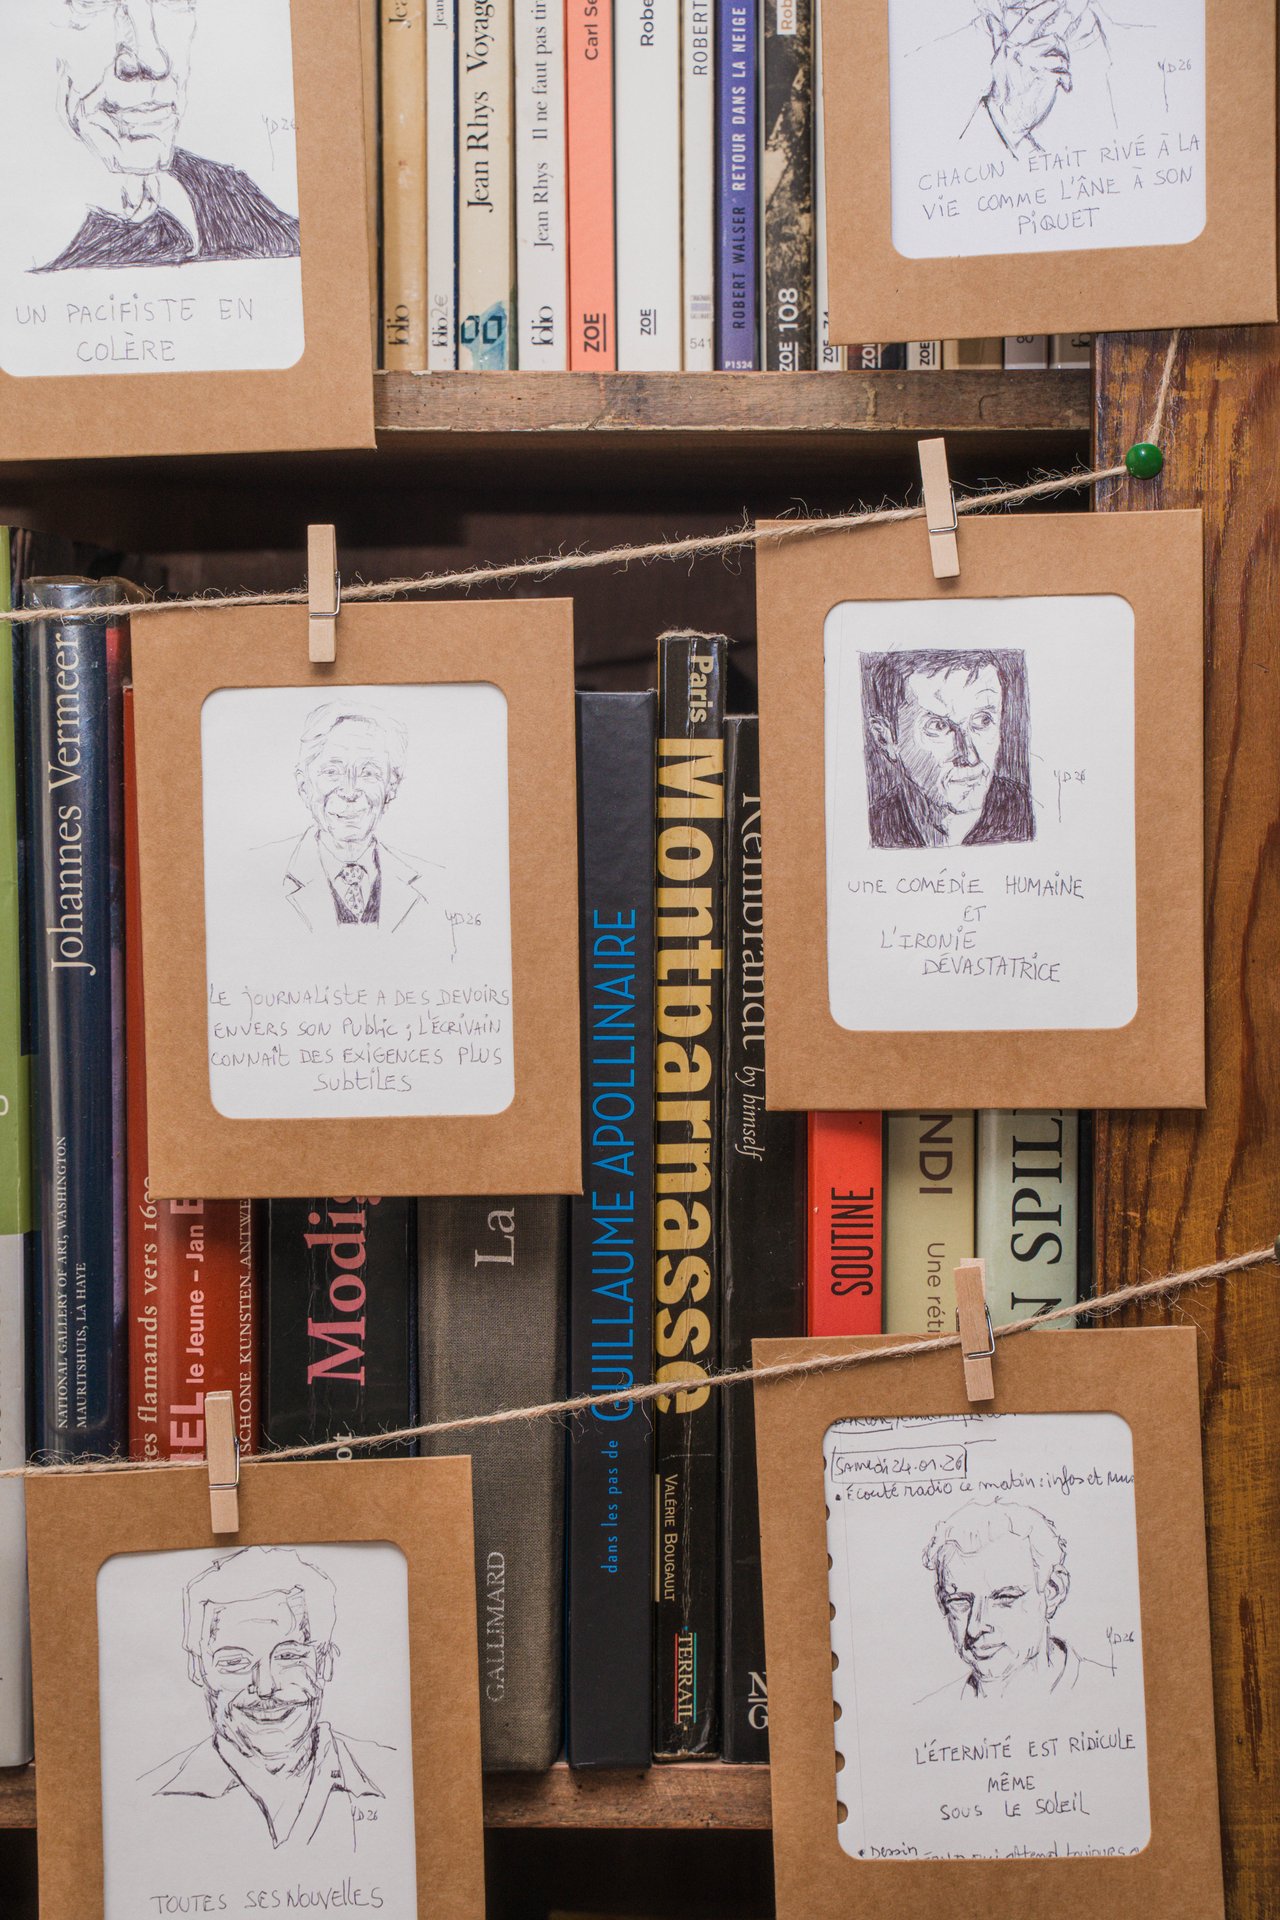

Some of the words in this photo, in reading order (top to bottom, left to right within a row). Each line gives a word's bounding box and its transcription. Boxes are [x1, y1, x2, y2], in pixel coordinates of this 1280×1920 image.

[535, 26, 552, 55] pas
[584, 24, 599, 60] Carl
[692, 0, 708, 76] ROBERT
[731, 7, 747, 53] NEIGE
[531, 60, 548, 96] faut
[731, 61, 746, 78] LA
[466, 91, 495, 151] Rhys
[535, 101, 548, 121] ne
[731, 86, 747, 125] DANS
[532, 161, 554, 203] Rhys
[731, 133, 747, 191] RETOUR
[918, 160, 1005, 191] CHACUN
[1178, 132, 1200, 152] LA
[466, 160, 494, 213] Jean
[977, 188, 1048, 213] COMME
[1153, 166, 1193, 187] SON
[533, 211, 554, 251] Jean
[732, 206, 746, 264] WALSER
[15, 303, 47, 325] UN
[219, 298, 253, 321] EN
[732, 272, 746, 329] ROBERT
[777, 287, 799, 332] 108
[531, 305, 554, 347] folio
[583, 312, 600, 353] ZOE
[640, 308, 652, 336] ZOE
[76, 331, 176, 362] COLÈRE
[724, 360, 753, 370] P1524
[689, 655, 714, 724] Paris
[48, 632, 82, 795] Vermeer
[46, 804, 97, 977] Johannes
[963, 906, 987, 922] ET
[209, 983, 231, 1007] LE
[394, 989, 430, 1006] DES
[214, 1021, 288, 1039] ENVERS
[297, 1021, 331, 1037] SON
[591, 908, 636, 1178] APOLLINAIRE
[299, 1048, 333, 1064] DES
[459, 1043, 502, 1065] PLUS
[656, 738, 725, 1415] Montparnasse
[735, 1065, 765, 1088] by
[56, 1136, 68, 1230] WASHINGTON
[1010, 1109, 1063, 1266] SPIL
[186, 1225, 204, 1262] Jan
[474, 1207, 516, 1268] La
[830, 1187, 874, 1297] SOUTINE
[57, 1269, 68, 1287] OF
[75, 1263, 87, 1300] HAYE
[143, 1243, 158, 1295] vers
[927, 1242, 946, 1288] Une
[57, 1294, 68, 1354] GALLERY
[76, 1304, 87, 1322] LA
[186, 1289, 204, 1357] Jeune
[591, 1190, 635, 1422] GUILLAUME
[137, 1305, 158, 1424] flamands
[186, 1363, 204, 1384] le
[57, 1357, 69, 1429] NATIONAL
[239, 1371, 252, 1453] SCHONE
[601, 1439, 619, 1458] de
[608, 1467, 623, 1494] pas
[903, 1479, 953, 1497] radio
[600, 1503, 618, 1528] les
[600, 1535, 618, 1573] dans
[486, 1551, 506, 1703] GALLIMARD
[678, 1632, 693, 1724] TERRAIL
[1028, 1737, 1058, 1758] EST
[987, 1772, 1036, 1793] MÊME
[940, 1804, 983, 1821] SOUS
[1004, 1801, 1021, 1817] LE
[150, 1892, 228, 1914] TOUTES
[244, 1889, 281, 1910] SES
